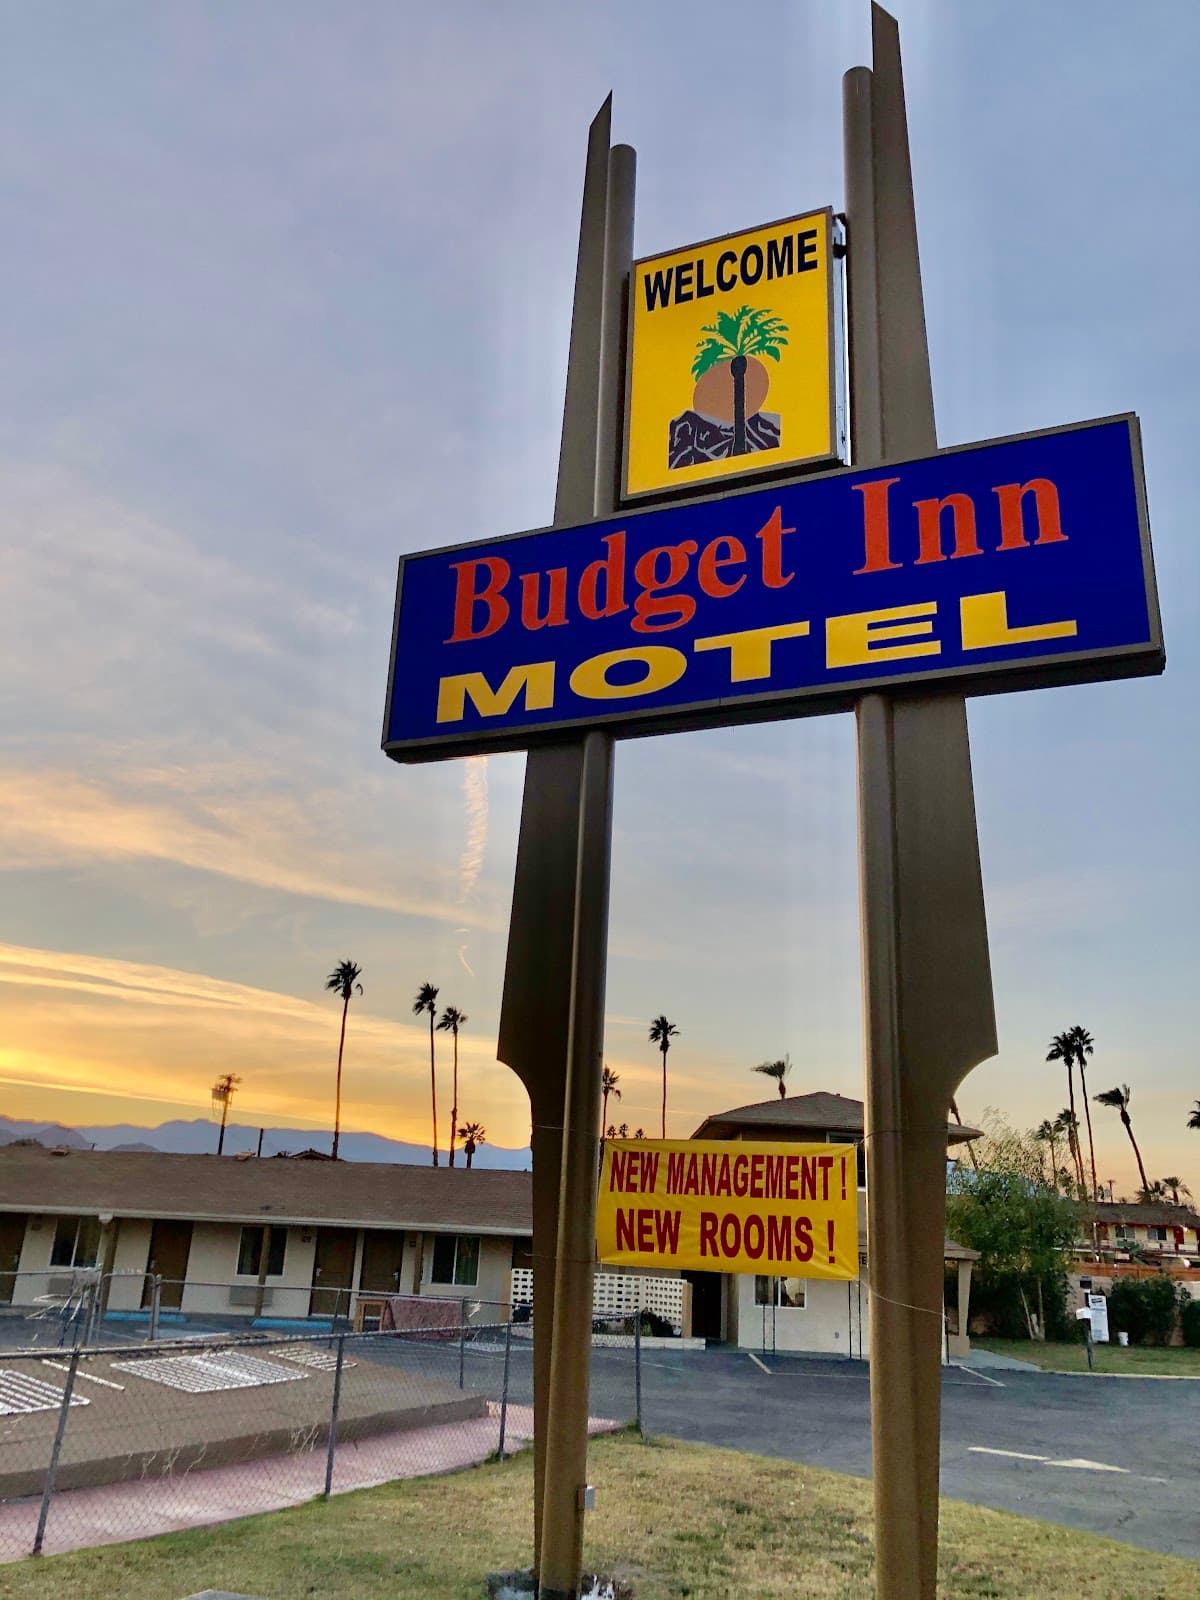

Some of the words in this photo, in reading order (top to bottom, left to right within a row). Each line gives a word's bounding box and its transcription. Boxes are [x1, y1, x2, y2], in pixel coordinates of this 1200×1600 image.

[643, 229, 818, 312] WELCOME
[443, 505, 796, 644] Budget
[851, 476, 1070, 576] Inn
[435, 590, 1078, 724] MOTEL
[609, 1150, 659, 1194] NEW
[615, 1207, 682, 1255] NEW
